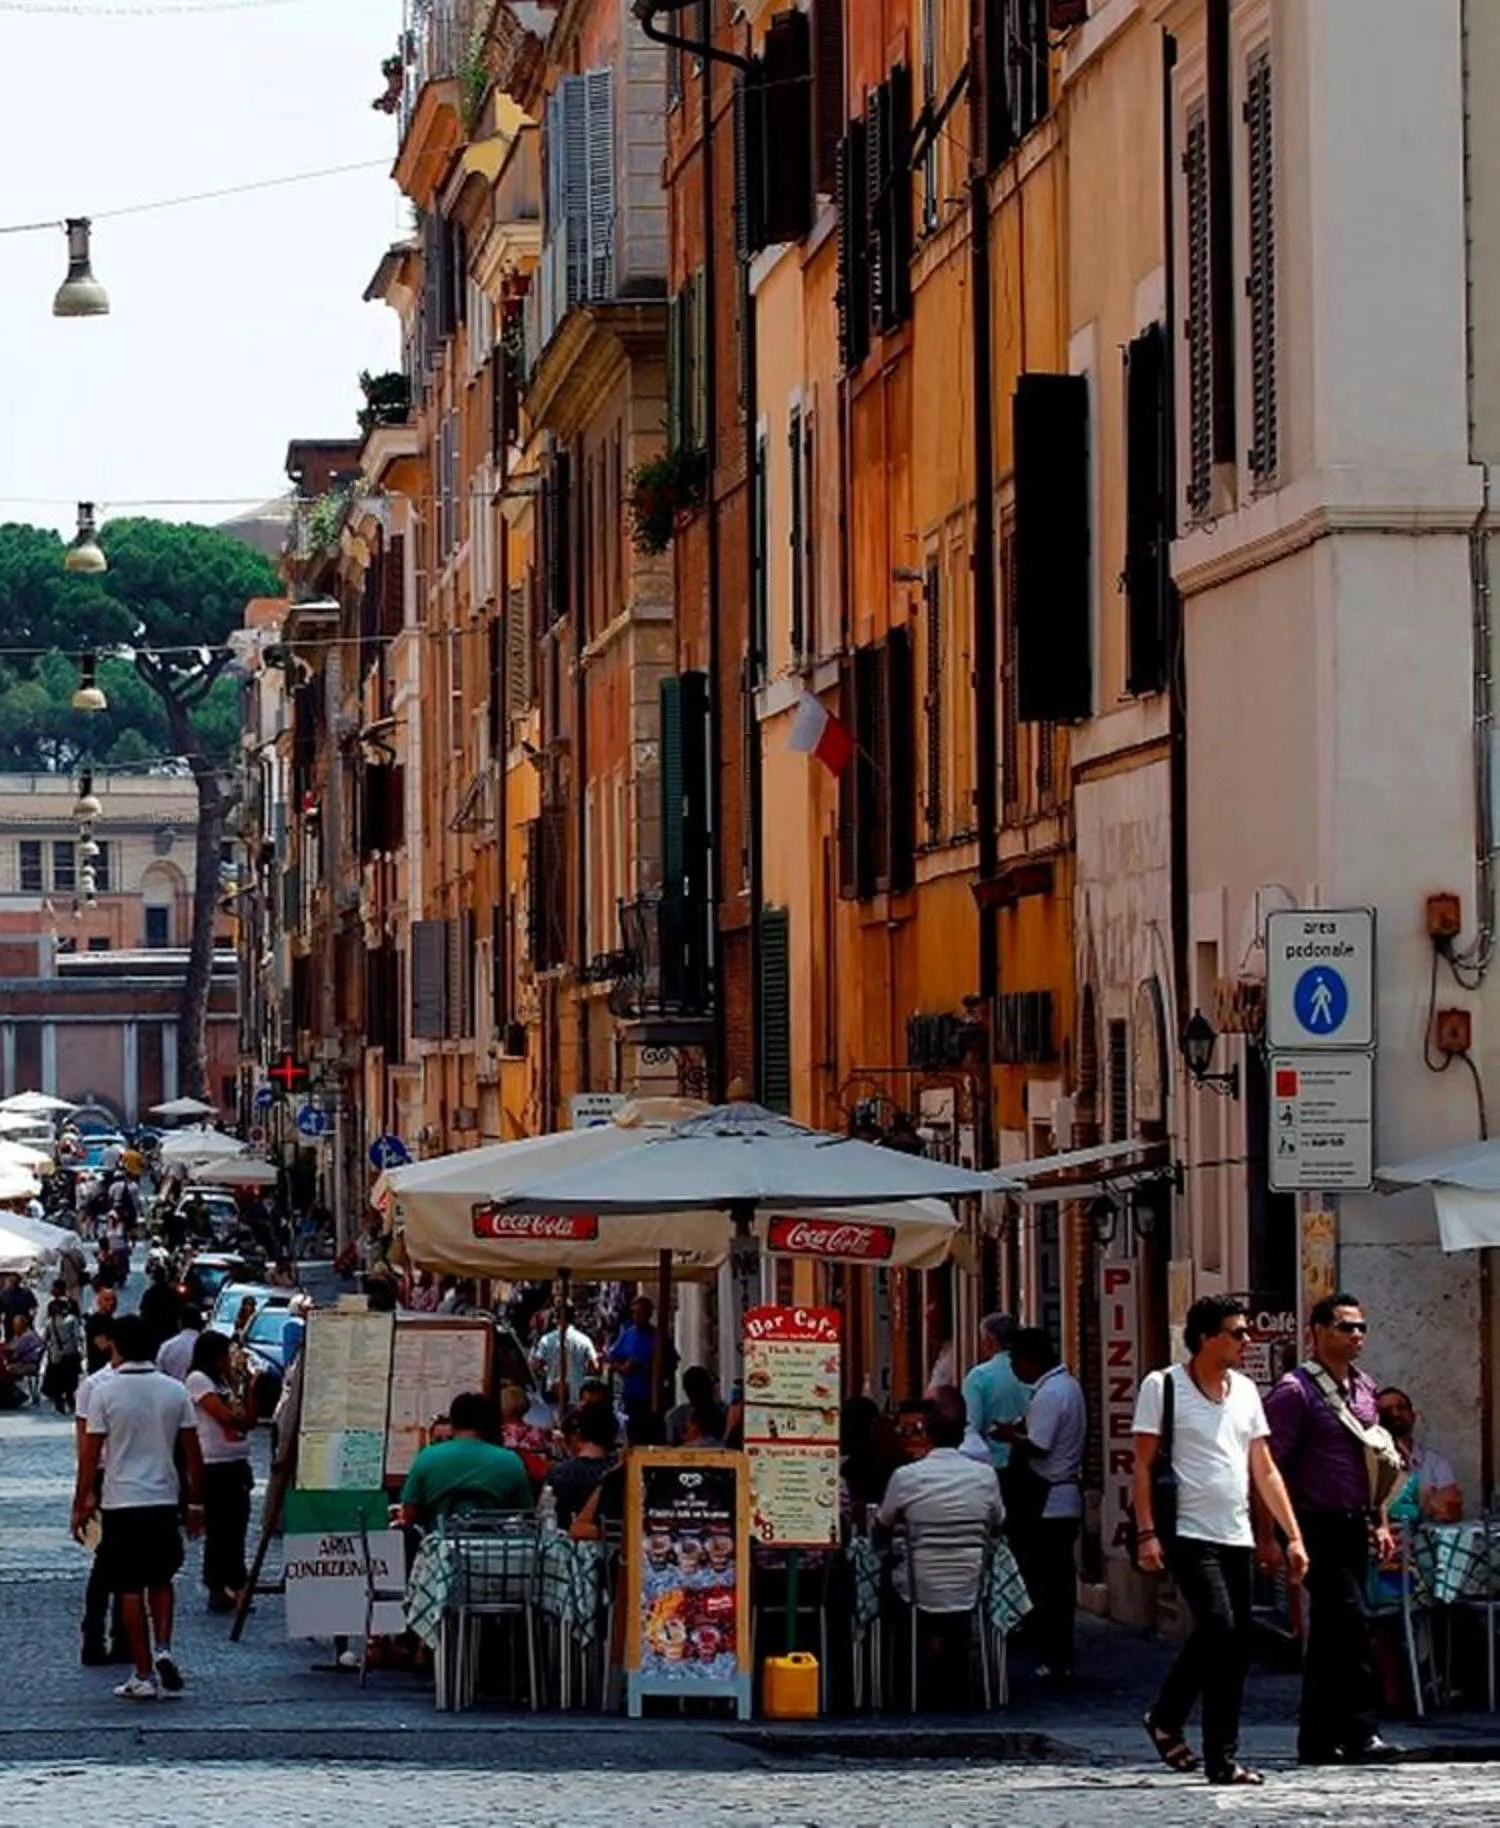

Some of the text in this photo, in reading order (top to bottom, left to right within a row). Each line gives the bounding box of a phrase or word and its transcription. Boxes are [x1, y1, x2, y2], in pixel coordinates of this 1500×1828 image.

[1303, 922, 1337, 935] area
[1285, 941, 1355, 960] pedonale
[492, 1213, 573, 1236] Coca-Cola
[786, 1221, 876, 1254] Coca-Cola
[747, 1314, 784, 1338] Bar
[1104, 1268, 1135, 1547] PIZZERIA
[318, 1536, 355, 1555] ARIA
